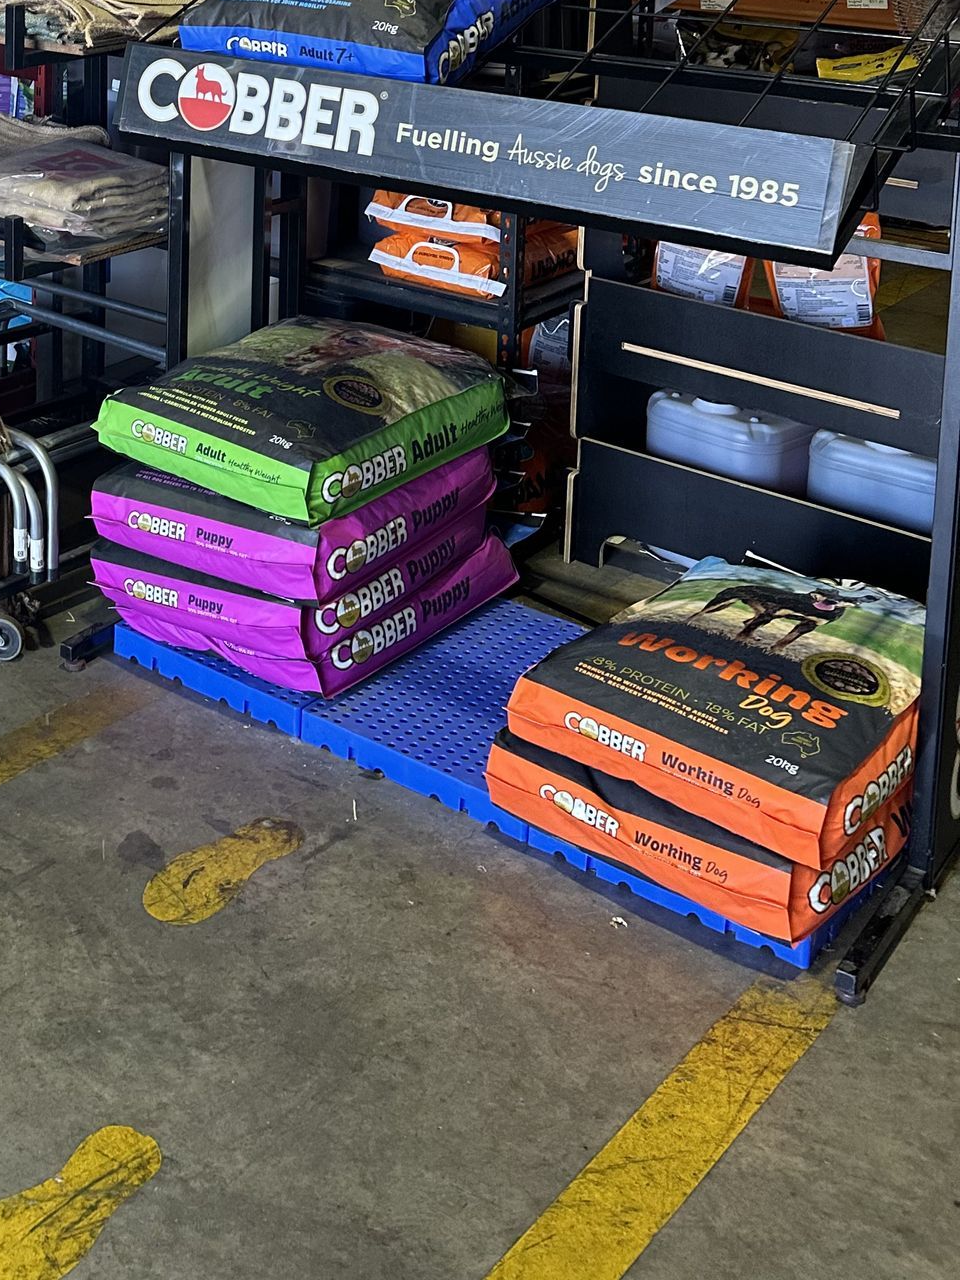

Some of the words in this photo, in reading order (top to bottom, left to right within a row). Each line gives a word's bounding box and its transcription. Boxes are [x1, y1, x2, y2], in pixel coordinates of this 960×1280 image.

[299, 46, 334, 62] Adult
[334, 47, 355, 65] 7+
[372, 20, 399, 35] 20kg
[136, 57, 382, 157] COBBER
[395, 123, 500, 163] Fuelling
[507, 133, 575, 172] Aussie
[576, 144, 628, 193] dogs
[638, 162, 718, 195] since
[727, 173, 801, 208] 1985
[171, 370, 274, 400] Adult
[131, 419, 188, 455] COBBER
[196, 442, 227, 463] Adult
[228, 458, 254, 474] Healthy
[254, 469, 281, 484] Weight
[321, 444, 407, 504] COBBER
[411, 422, 458, 465] Adult
[127, 509, 187, 541] COBBER
[196, 526, 234, 549] Puppy
[327, 515, 408, 581] COBBER
[411, 486, 460, 532] Puppy
[123, 578, 179, 609] COBBER
[188, 594, 224, 614] Puppy
[314, 567, 405, 635] COBBER
[406, 536, 456, 584] Puppy
[331, 605, 417, 671] COBBER
[421, 576, 471, 621] Puppy
[574, 666, 607, 684] STAMINA,
[607, 678, 642, 698] RECOVERY
[642, 693, 658, 704] AND
[658, 699, 687, 717] MENTAL
[687, 713, 729, 735] ALERTNESS
[578, 662, 622, 683] FORMULATED
[623, 679, 642, 691] WITH
[681, 703, 692, 712] TO
[692, 708, 718, 723] ASSIST
[618, 630, 849, 731] Working
[620, 666, 690, 701] PROTEIN
[705, 701, 735, 722] 18%
[737, 716, 770, 735] FAT
[738, 694, 793, 729] Dog
[564, 710, 648, 762] COBBER
[661, 751, 735, 797] Working
[737, 787, 761, 808] Dog
[764, 754, 800, 776] 20kg
[843, 744, 913, 836] COBBER
[539, 783, 620, 838] COBBER
[634, 830, 703, 871] Working
[705, 861, 728, 883] Dog
[807, 826, 889, 914] COBBER
